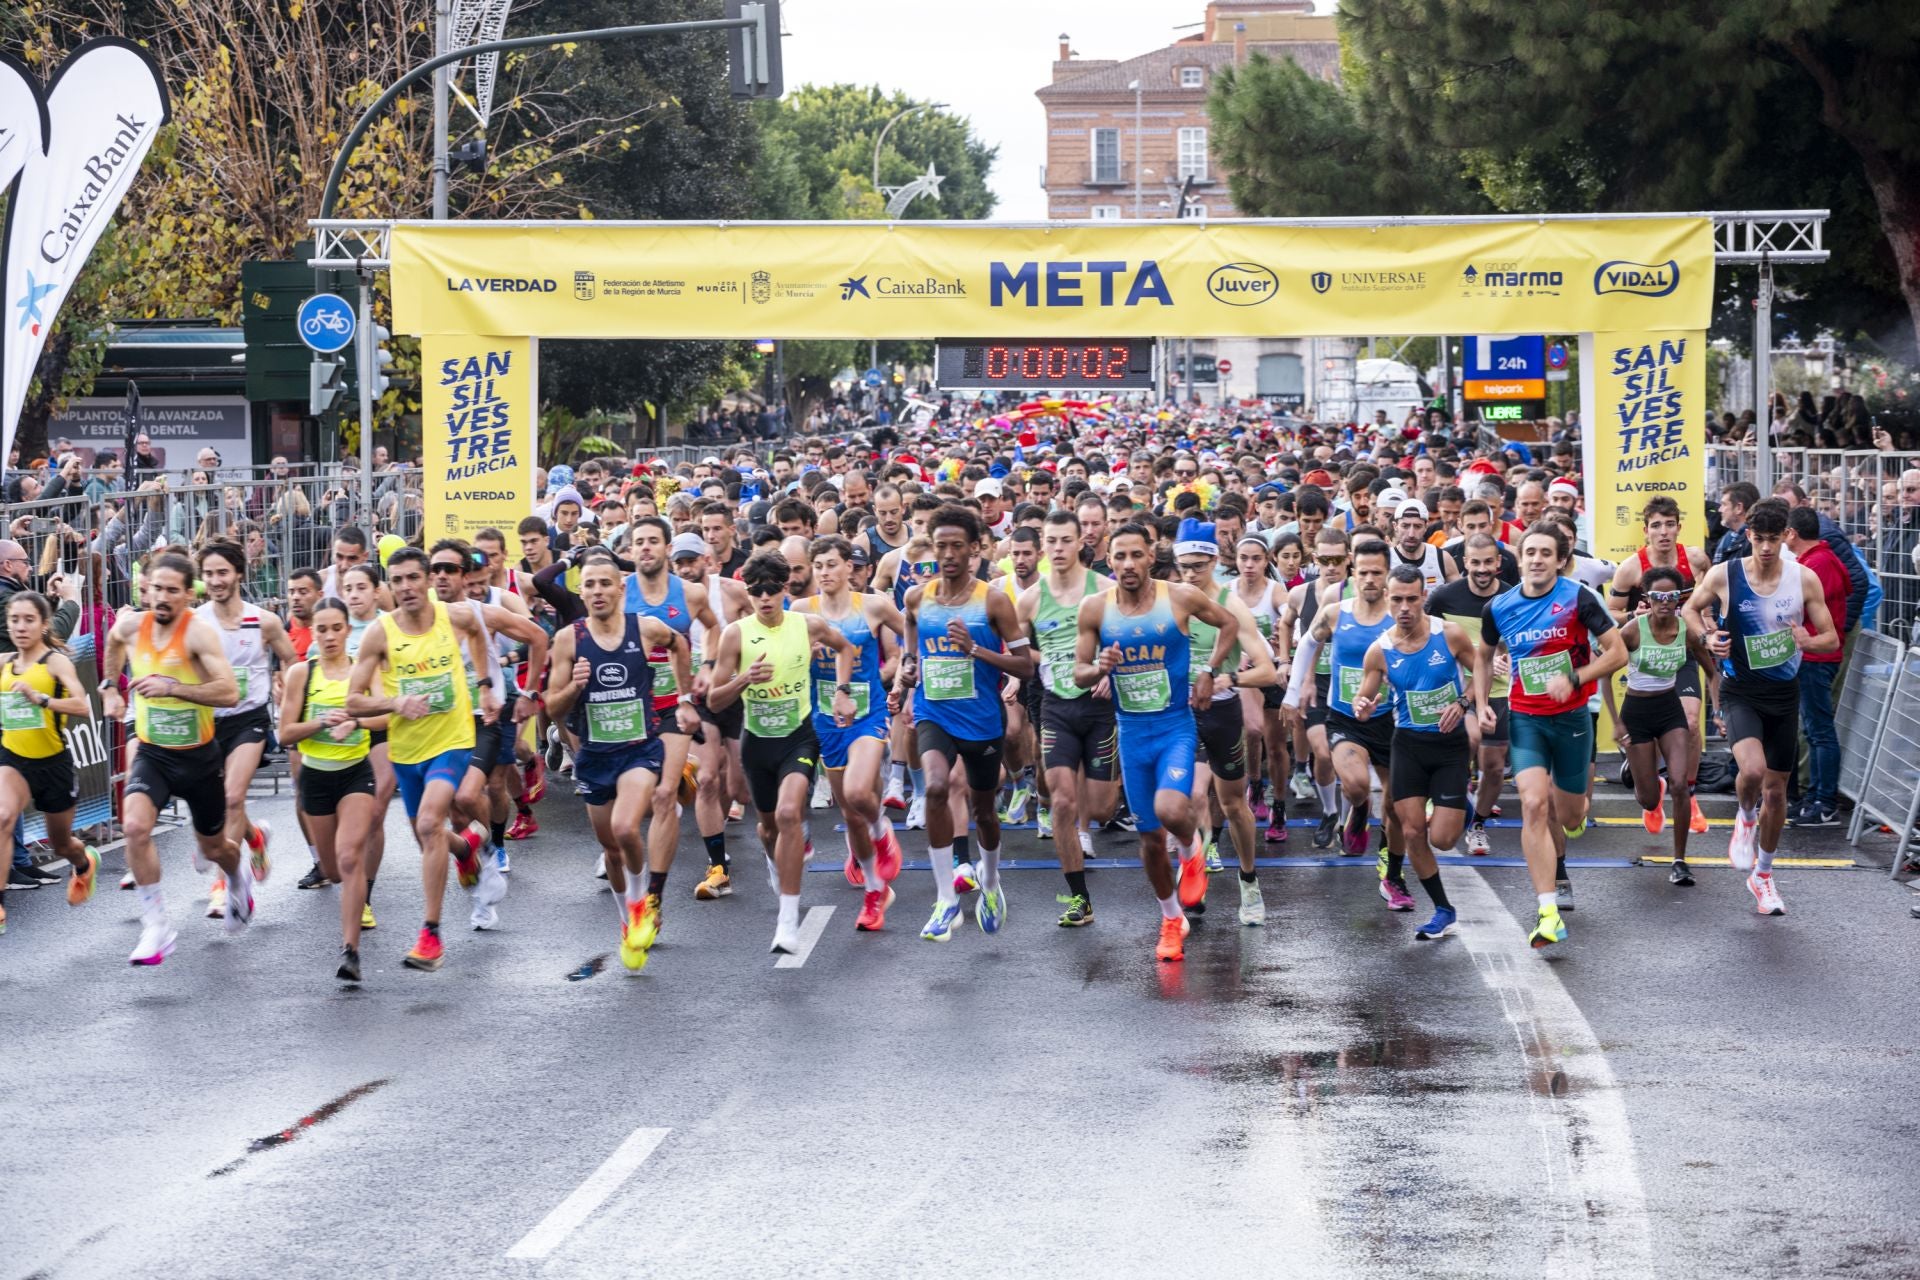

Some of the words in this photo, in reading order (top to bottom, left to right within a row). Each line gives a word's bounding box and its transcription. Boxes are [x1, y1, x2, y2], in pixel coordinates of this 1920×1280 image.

[41, 113, 146, 264] CaixaBank
[447, 278, 473, 291] LA
[475, 278, 557, 292] VERDAD
[603, 279, 641, 287] Federación
[642, 279, 651, 287] de
[652, 279, 686, 287] Atletismo
[876, 276, 967, 295] CaixaBank
[989, 260, 1174, 307] META
[1214, 276, 1271, 296] Juver
[1341, 272, 1426, 284] UNIVERSAE
[1485, 271, 1563, 287] marmo
[1607, 271, 1668, 287] VIDAL
[621, 287, 646, 297] Región
[987, 347, 1129, 379] 0:00:02
[1498, 356, 1528, 370] 24h
[1611, 338, 1687, 375] SAN
[440, 350, 512, 386] SAN
[1484, 384, 1525, 395] telpark
[1621, 367, 1675, 402] SIL
[450, 379, 502, 412] SIL
[158, 410, 224, 421] AVANZADA
[1485, 405, 1522, 419] LIBRE
[1616, 391, 1684, 428] VES
[444, 402, 511, 437] VES
[80, 425, 88, 435] Y
[150, 424, 199, 435] DENTAL
[1617, 419, 1685, 455] TRE
[446, 430, 512, 464] TRE
[1616, 445, 1690, 472] MURCIA
[446, 455, 518, 481] MURCIA
[1616, 482, 1633, 492] LA
[1635, 481, 1687, 491] VERDAD
[445, 491, 462, 501] LA
[464, 491, 515, 501] VERDAD
[1760, 644, 1788, 659] 804
[931, 677, 963, 689] 3182
[1126, 688, 1160, 702] 1326
[600, 719, 634, 732] 1755
[759, 716, 789, 727] 092
